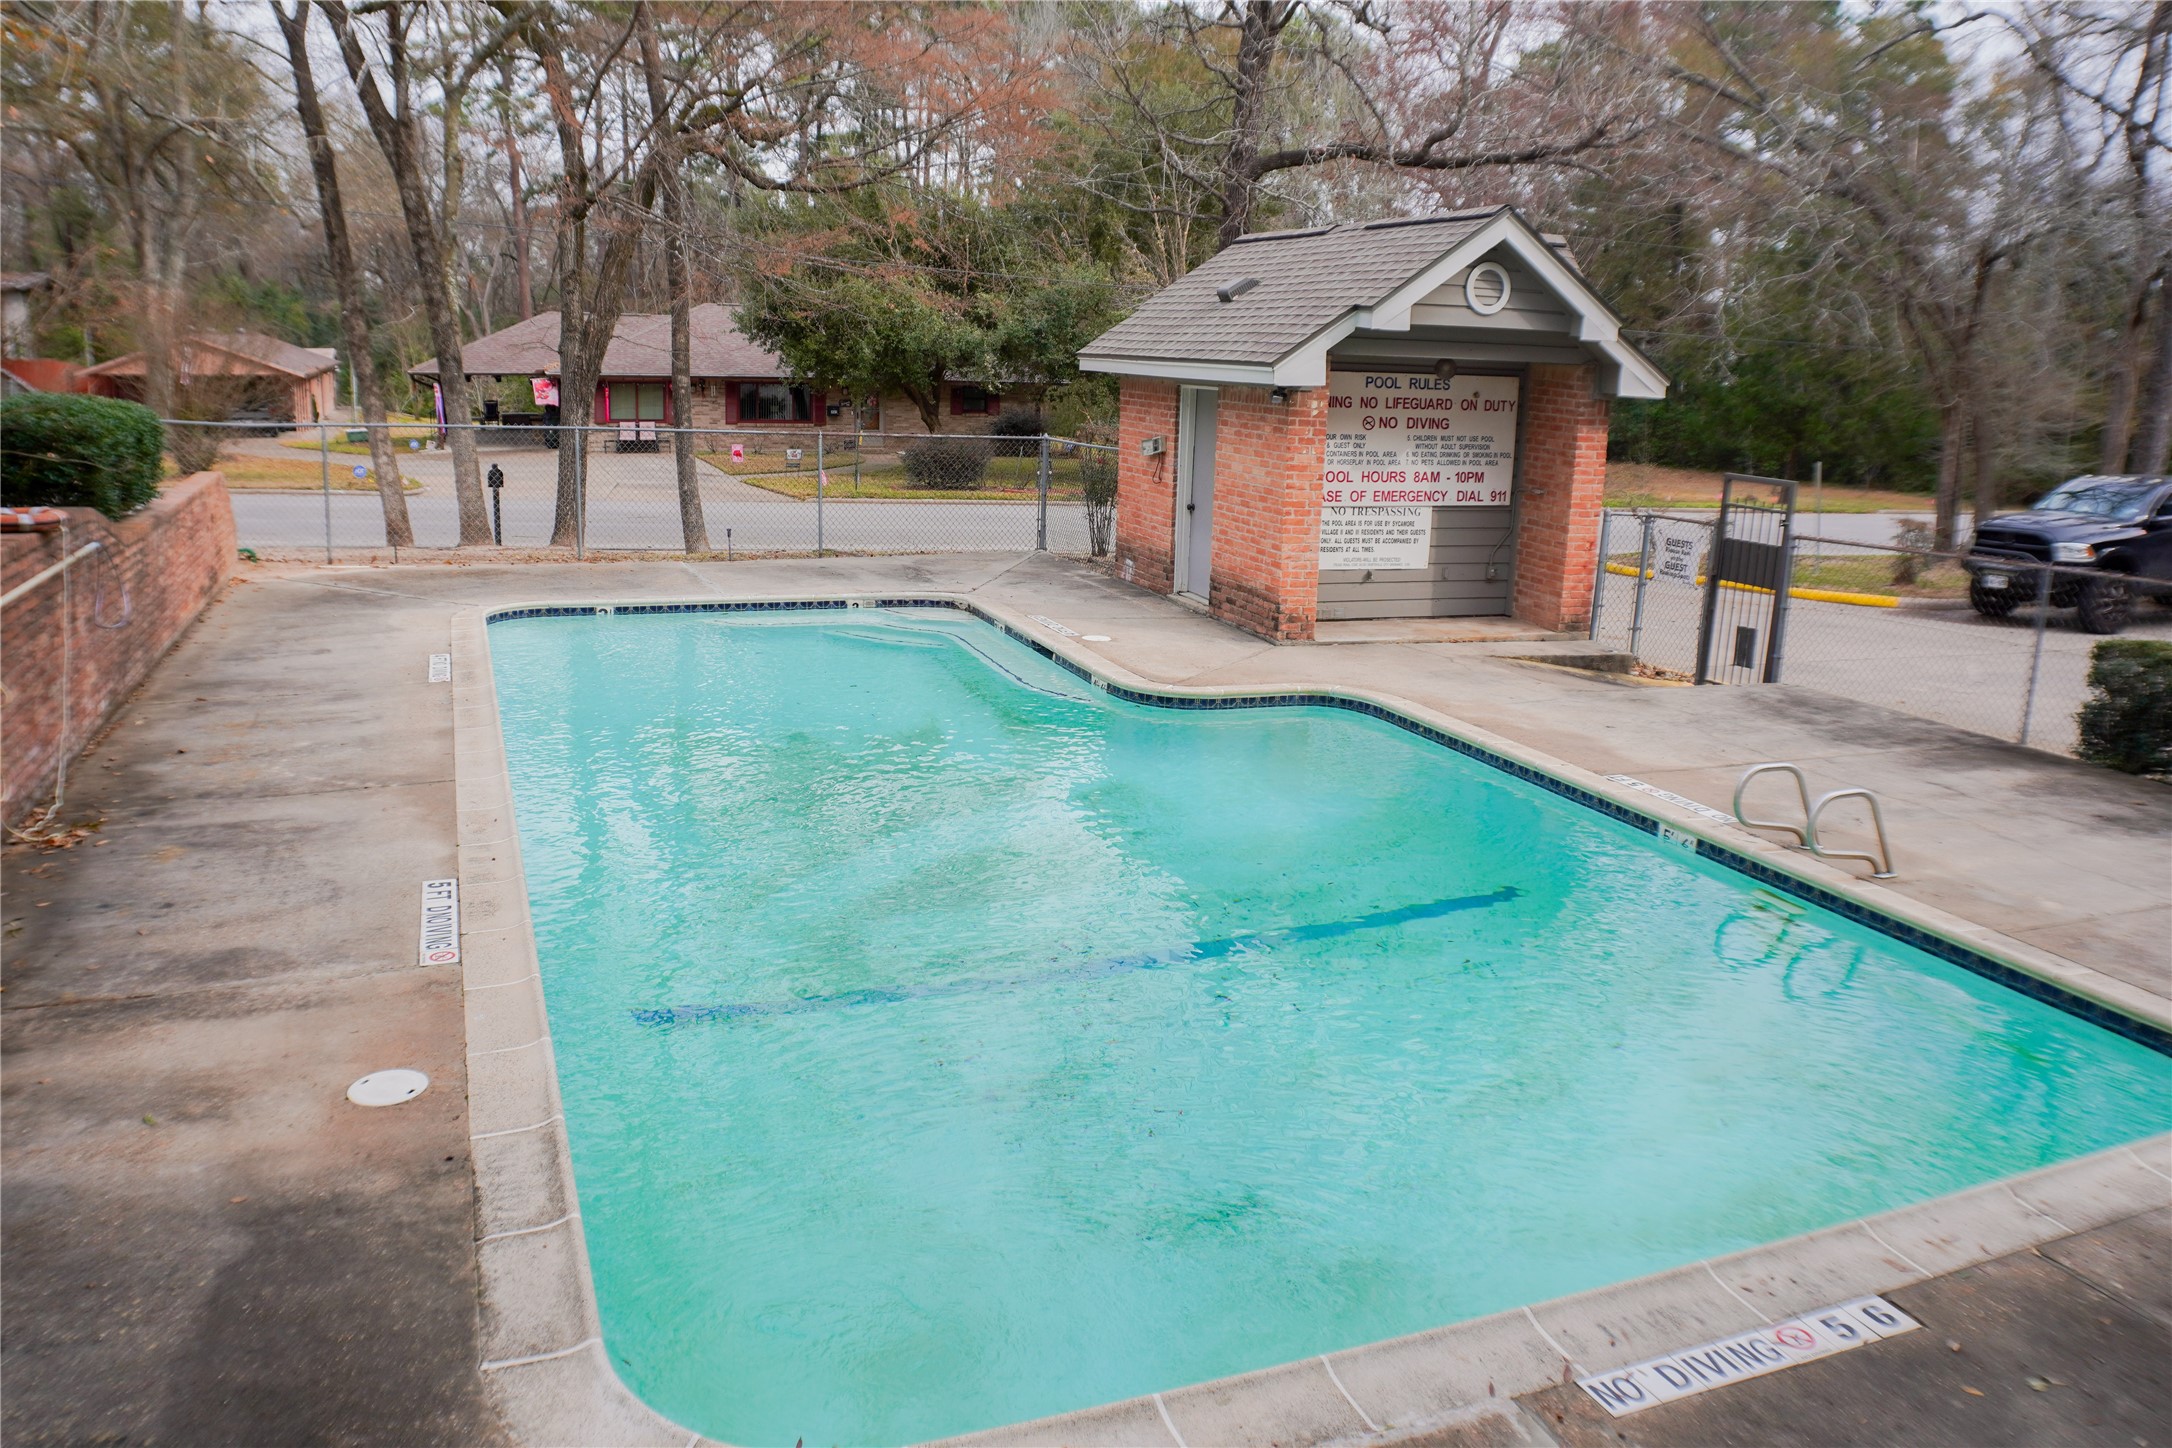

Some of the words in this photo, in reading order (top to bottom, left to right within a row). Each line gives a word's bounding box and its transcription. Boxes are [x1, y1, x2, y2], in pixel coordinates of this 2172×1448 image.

[1365, 376, 1401, 389] POOL
[1409, 377, 1451, 390] RULES
[1360, 396, 1378, 409] NO
[1385, 397, 1453, 410] LIFEGUARD
[1460, 398, 1478, 411] ON
[1484, 399, 1516, 412] DUTY
[1379, 416, 1398, 429] NO
[1406, 417, 1450, 430] DIVING
[1340, 433, 1352, 441] OWN
[1355, 433, 1367, 441] RISK
[1459, 443, 1490, 451] SUPERVISION
[1326, 450, 1357, 458] CONTAINERS
[1485, 459, 1499, 467] AREA
[1325, 470, 1353, 483] OOL
[1361, 470, 1406, 483] HOURS
[1413, 470, 1440, 483] 8AM
[1455, 471, 1485, 483] 10PM
[1349, 490, 1367, 502] OF
[1373, 490, 1448, 502] EMERGENCY
[1457, 490, 1484, 502] DIAL
[1490, 490, 1507, 502] 911
[1331, 507, 1346, 516] NO
[1351, 507, 1421, 517] TRESPASSING
[1666, 537, 1693, 550] GUESTS
[1664, 560, 1688, 572] GUEST
[1711, 814, 1733, 822] NO
[426, 890, 452, 901] FT
[1586, 1374, 1648, 1411] NO
[1652, 1338, 1788, 1392] DIVING
[1819, 1314, 1862, 1343] 5
[1861, 1304, 1900, 1328] 6
